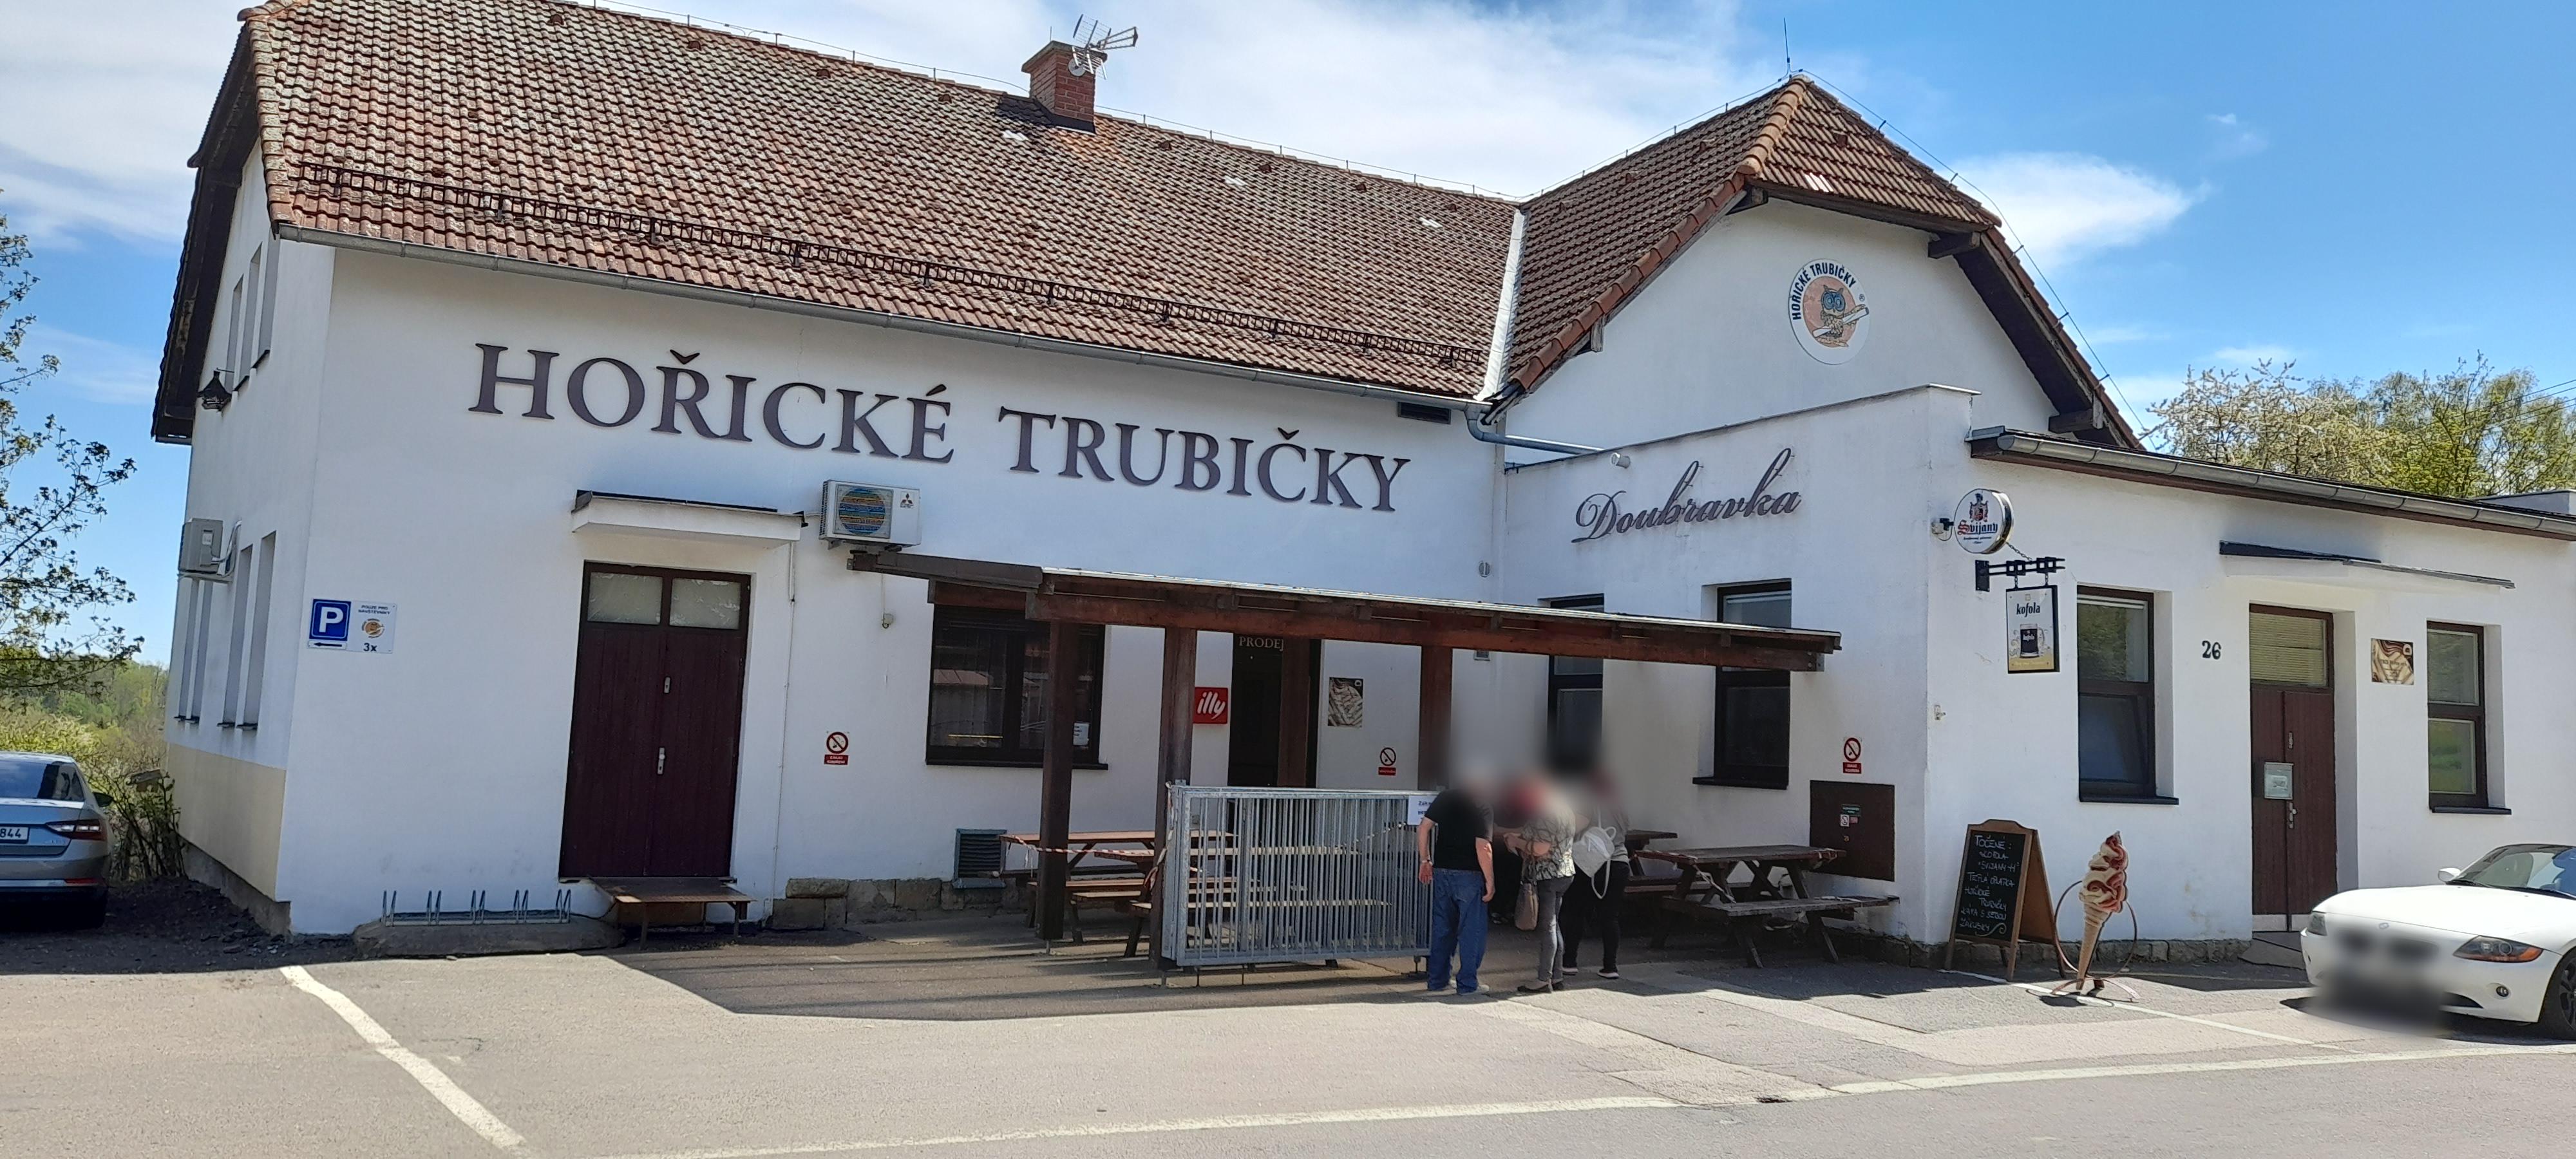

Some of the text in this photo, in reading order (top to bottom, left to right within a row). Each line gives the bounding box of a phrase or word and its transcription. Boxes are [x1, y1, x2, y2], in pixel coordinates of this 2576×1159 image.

[1791, 262, 1856, 320] HOŘICKÉ TRUBIČKY
[468, 343, 1412, 513] HOŘICKÉ TRUBIČKY
[1571, 448, 1802, 543] Doubravka
[1957, 519, 1998, 535] Svijany
[319, 606, 344, 633] P
[2016, 602, 2041, 618] kofola
[363, 643, 377, 652] 3x
[1238, 636, 1284, 652] PRODEJ
[2202, 640, 2222, 660] 26
[1197, 691, 1226, 720] illy
[0, 828, 21, 838] 844
